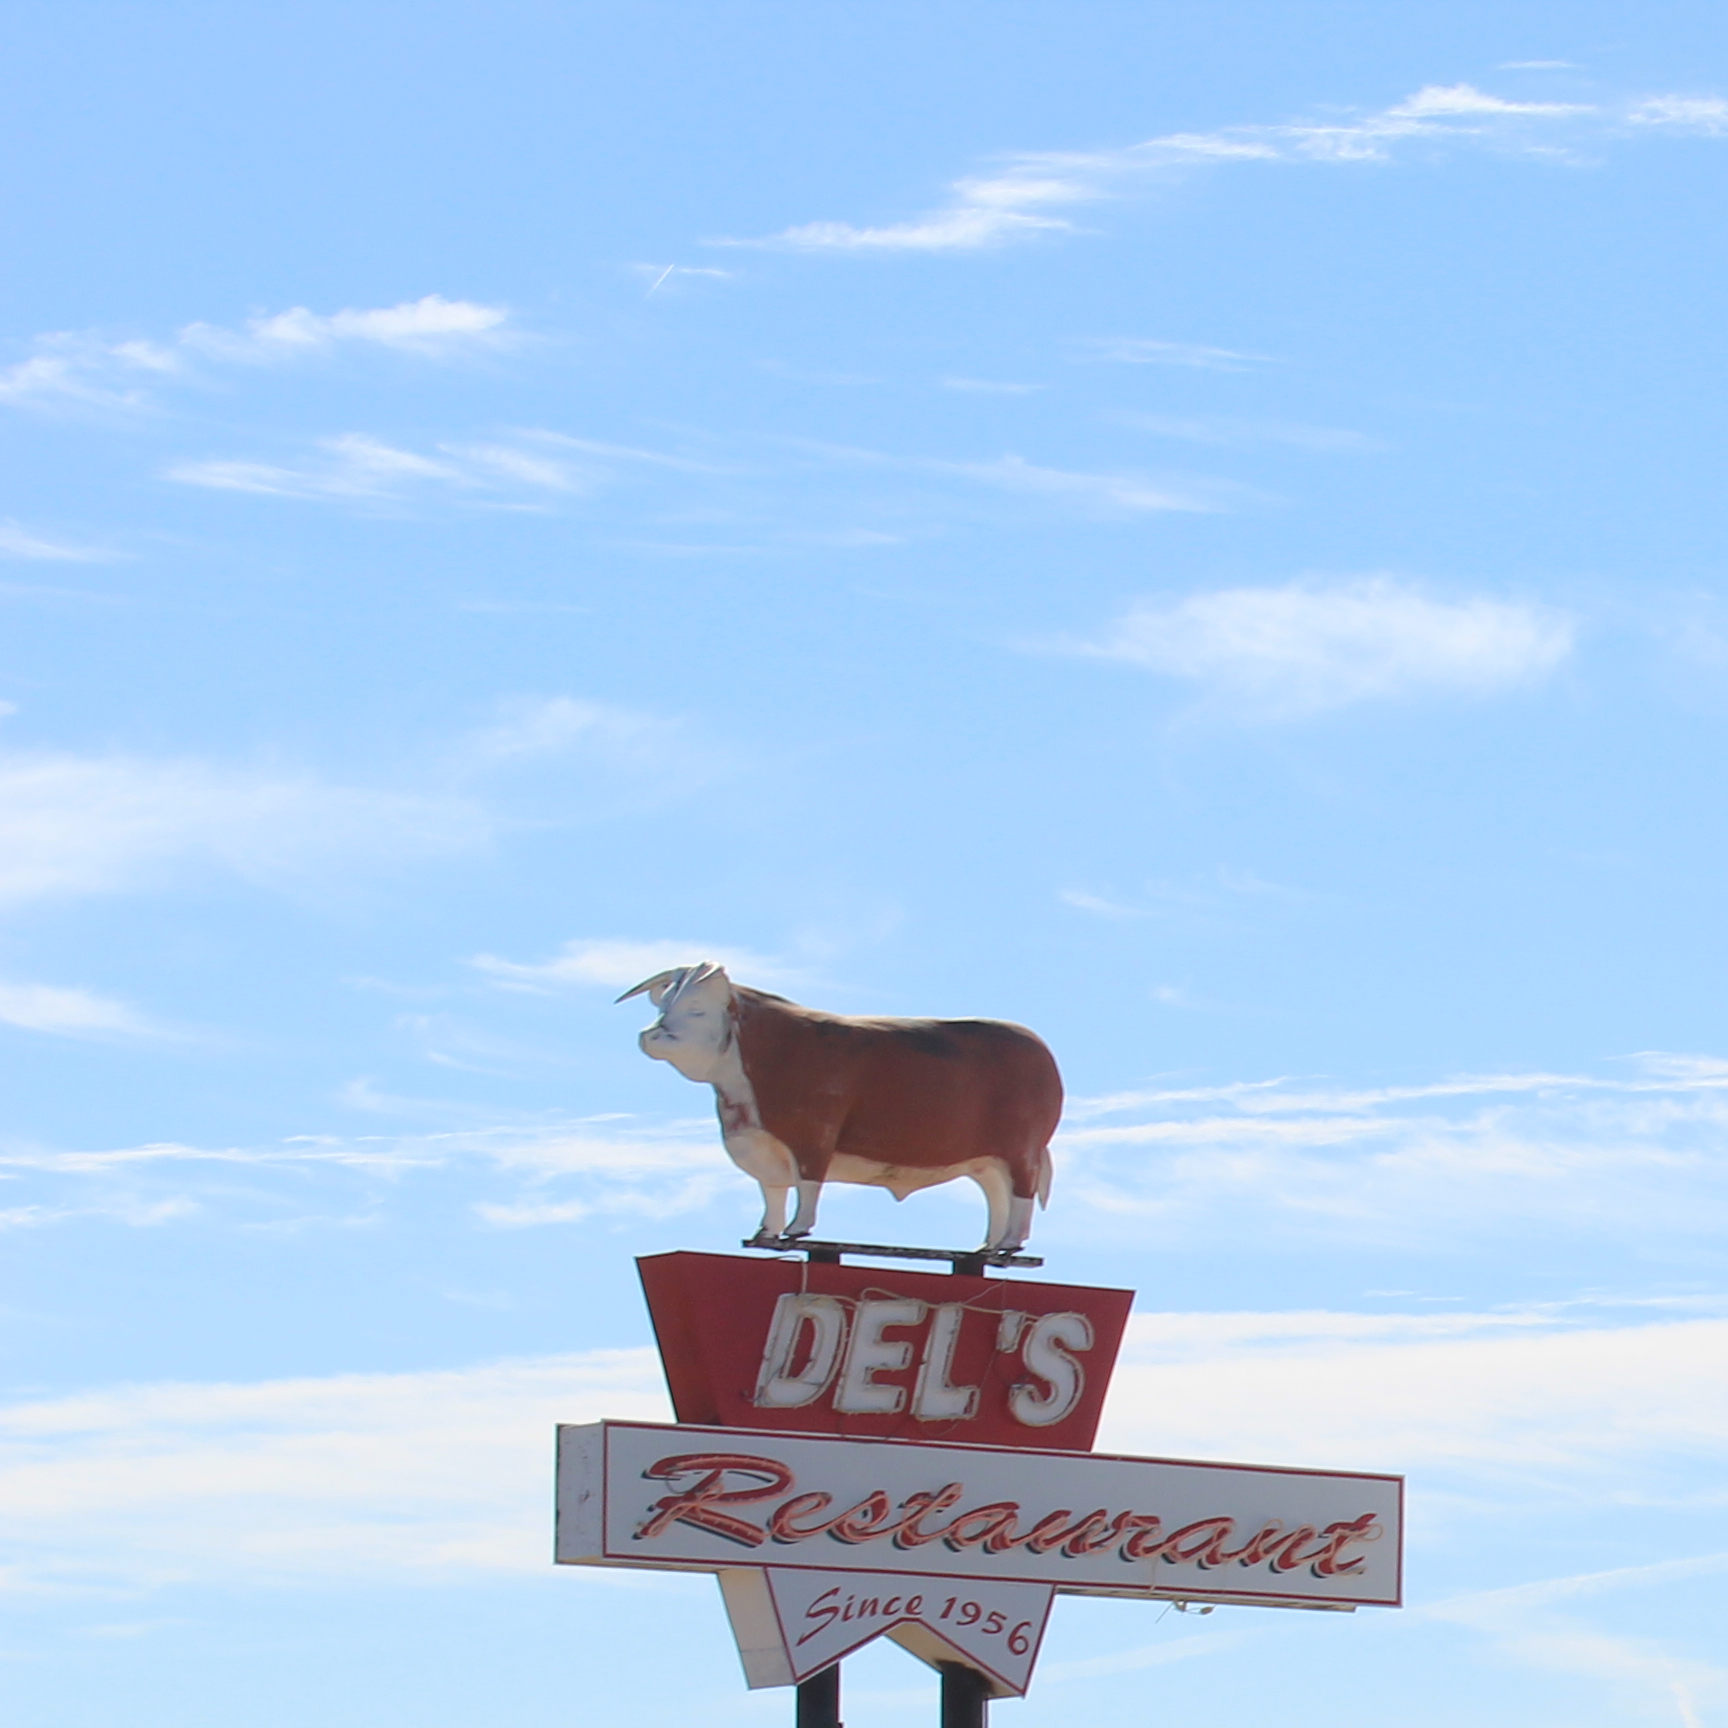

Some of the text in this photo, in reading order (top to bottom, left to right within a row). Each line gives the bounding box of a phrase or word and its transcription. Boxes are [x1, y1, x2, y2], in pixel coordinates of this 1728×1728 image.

[753, 1292, 1094, 1428] DEL'S
[633, 1452, 1384, 1579] Restaurant
[796, 1587, 1030, 1656] Since 1956
